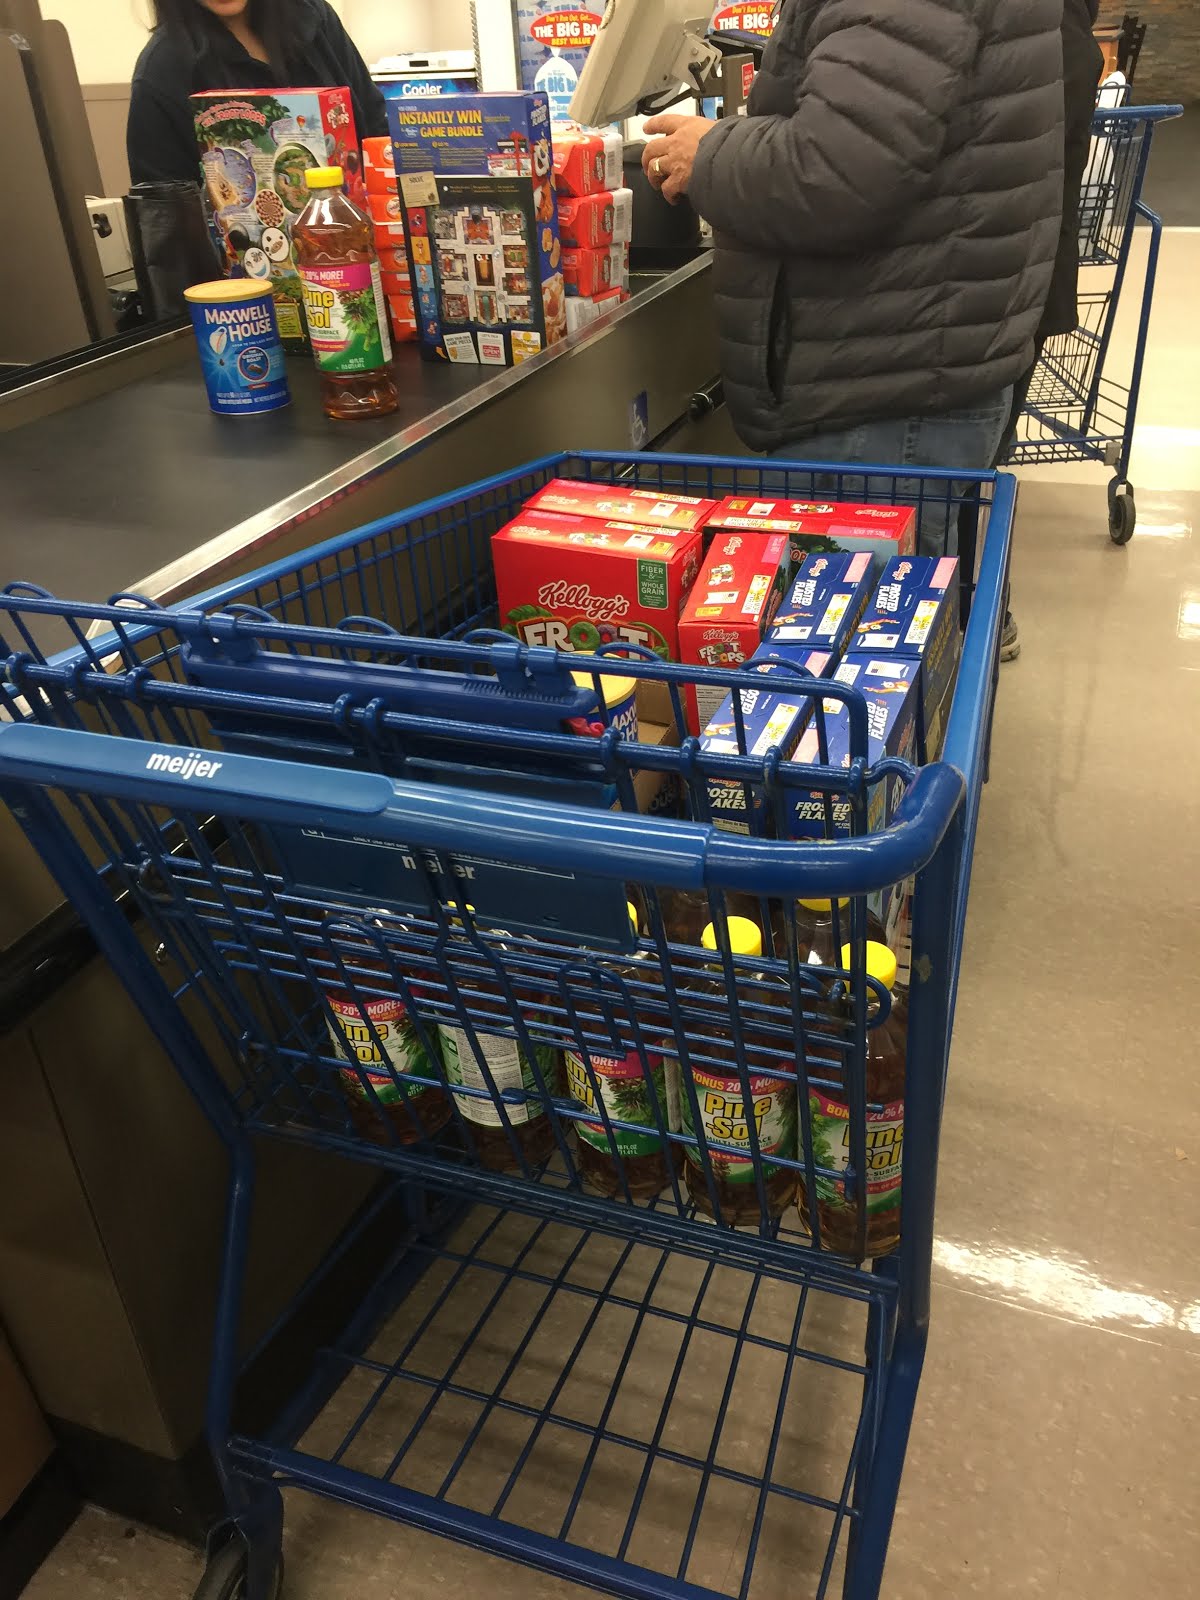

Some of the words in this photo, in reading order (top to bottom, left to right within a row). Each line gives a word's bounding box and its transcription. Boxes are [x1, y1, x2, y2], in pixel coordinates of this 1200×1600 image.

[732, 6, 746, 14] Don't
[718, 18, 740, 30] THE
[742, 13, 769, 30] BIG
[533, 25, 554, 38] THE
[556, 22, 581, 37] BIG
[583, 22, 601, 36] BA
[551, 37, 568, 46] BEST
[569, 37, 592, 45] VALUE
[402, 83, 443, 96] Cooler
[398, 111, 455, 125] INSTANTLY
[456, 110, 483, 124] WIN
[420, 127, 447, 138] GAME
[447, 126, 485, 137] BUNDLE
[320, 269, 344, 280] MORE!
[204, 304, 271, 326] MAXWELL
[227, 318, 273, 342] HOUSE
[640, 565, 664, 575] FIBER
[648, 572, 656, 580] &
[641, 581, 664, 590] WHOLE
[641, 587, 665, 596] GRAIN
[538, 579, 631, 622] Kellogg's
[875, 585, 891, 612] FLAKES
[887, 582, 902, 613] FROSTED
[523, 620, 649, 661] FROOT
[703, 628, 740, 643] Kellogg's
[698, 641, 741, 660] FROOT
[706, 651, 746, 666] LOOPS
[870, 706, 890, 741] FLAKES
[145, 752, 223, 780] meijer
[401, 854, 476, 880] meier
[367, 999, 401, 1016] MORE!
[691, 1069, 725, 1090] BONUS
[826, 1103, 850, 1119] BON
